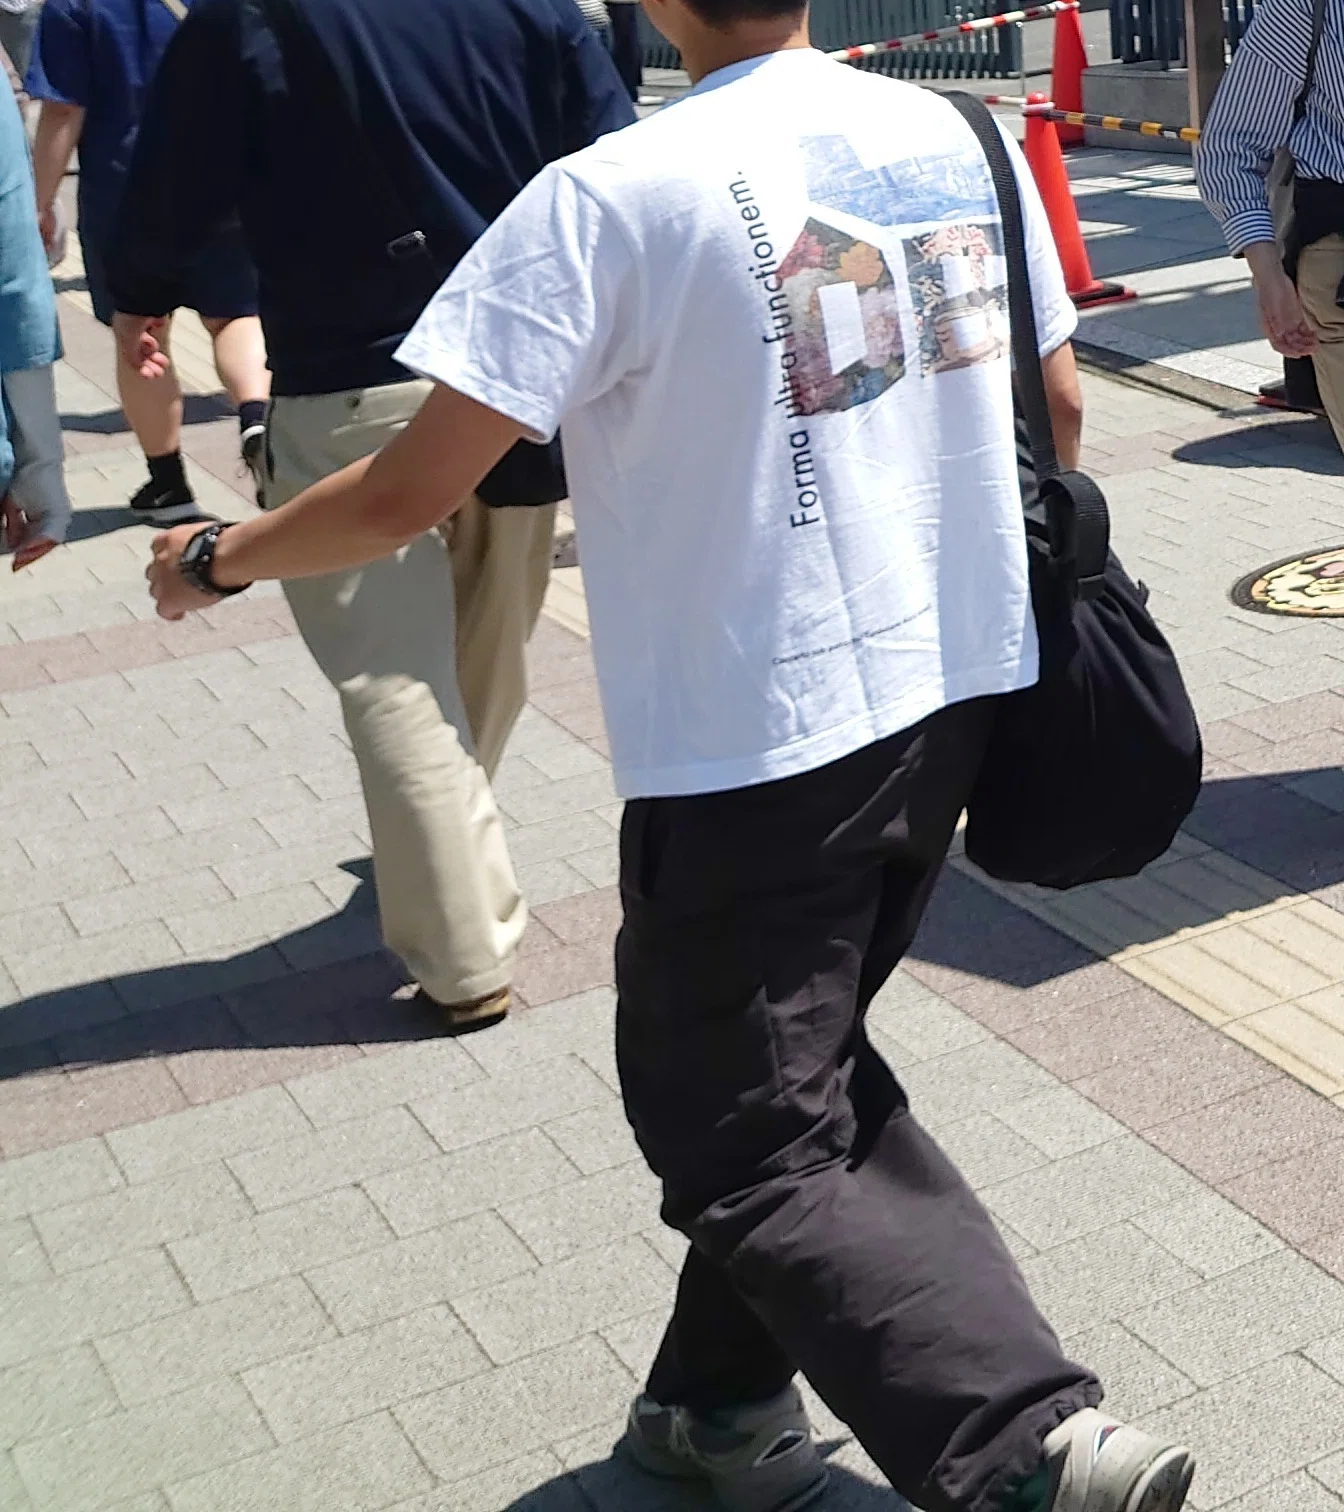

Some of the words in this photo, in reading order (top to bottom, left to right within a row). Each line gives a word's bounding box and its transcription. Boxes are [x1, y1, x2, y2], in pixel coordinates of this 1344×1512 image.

[728, 168, 793, 346] functionem.
[774, 350, 808, 421] ultra
[789, 430, 821, 529] Forma
